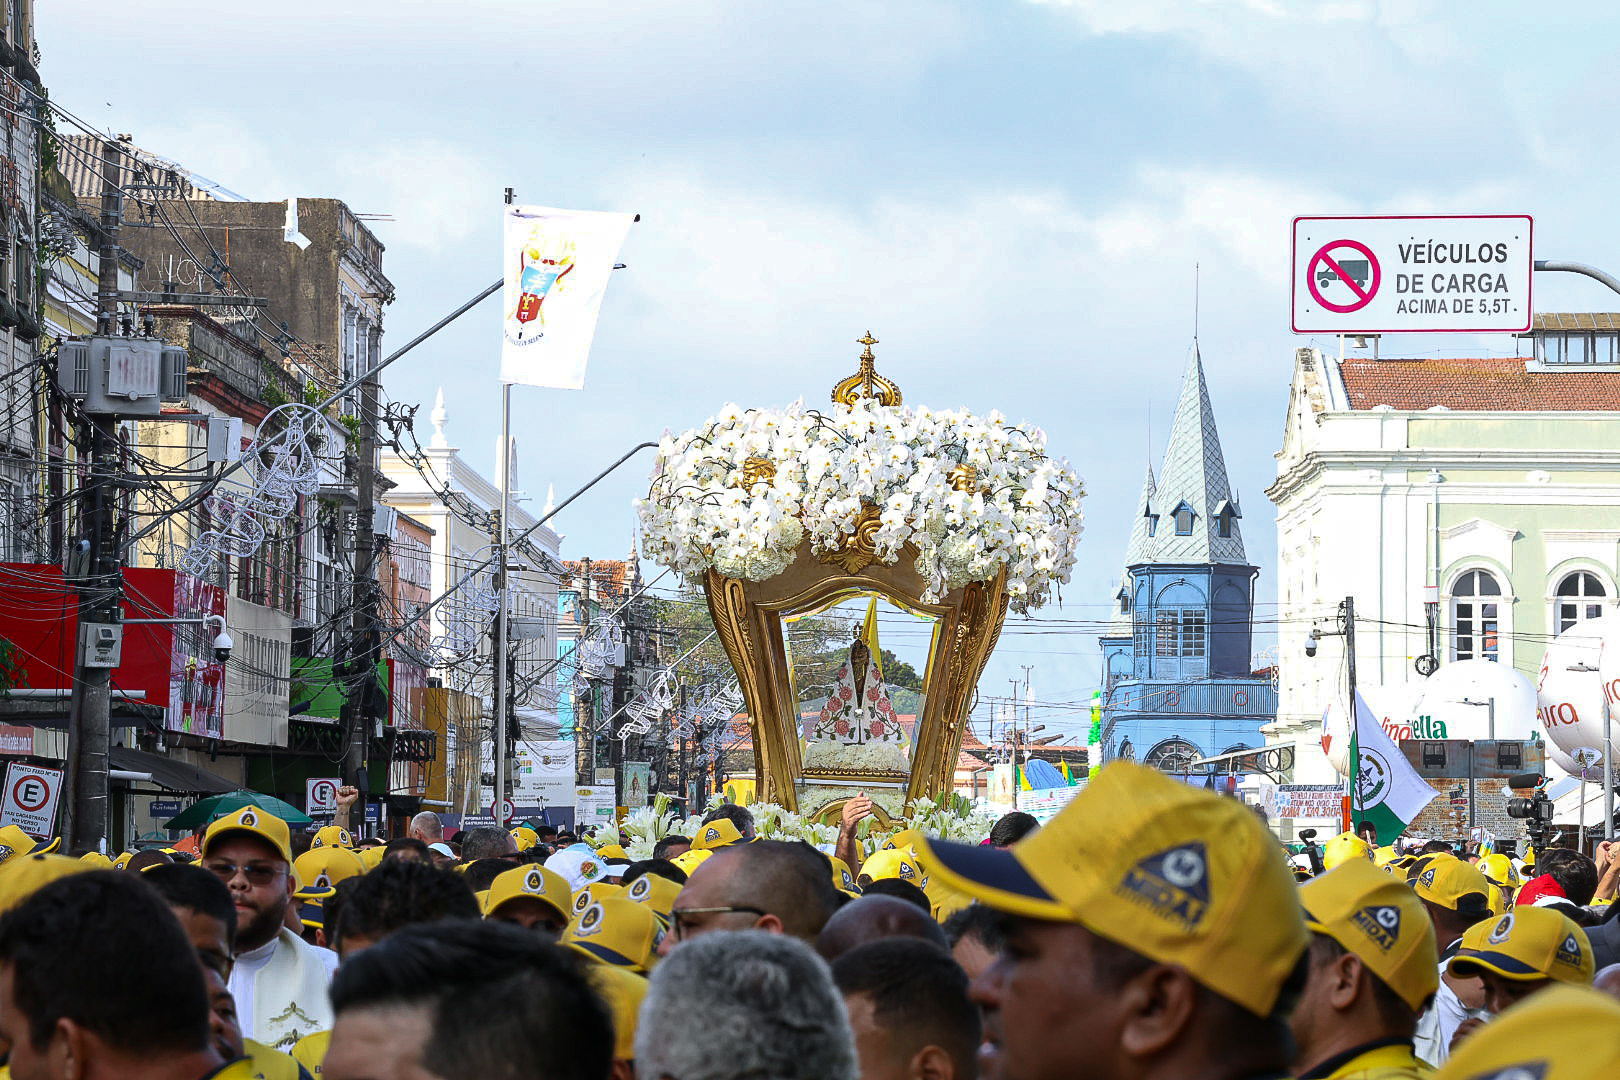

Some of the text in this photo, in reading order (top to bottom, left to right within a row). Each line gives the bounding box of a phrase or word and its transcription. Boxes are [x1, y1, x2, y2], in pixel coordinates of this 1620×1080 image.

[1398, 239, 1508, 264] VEÍCULOS
[1396, 273, 1509, 294] DE CARGA
[1396, 298, 1511, 316] ACIMA DE 5,5T
[12, 765, 31, 773] PONTO
[23, 783, 39, 803] E
[320, 786, 329, 800] E
